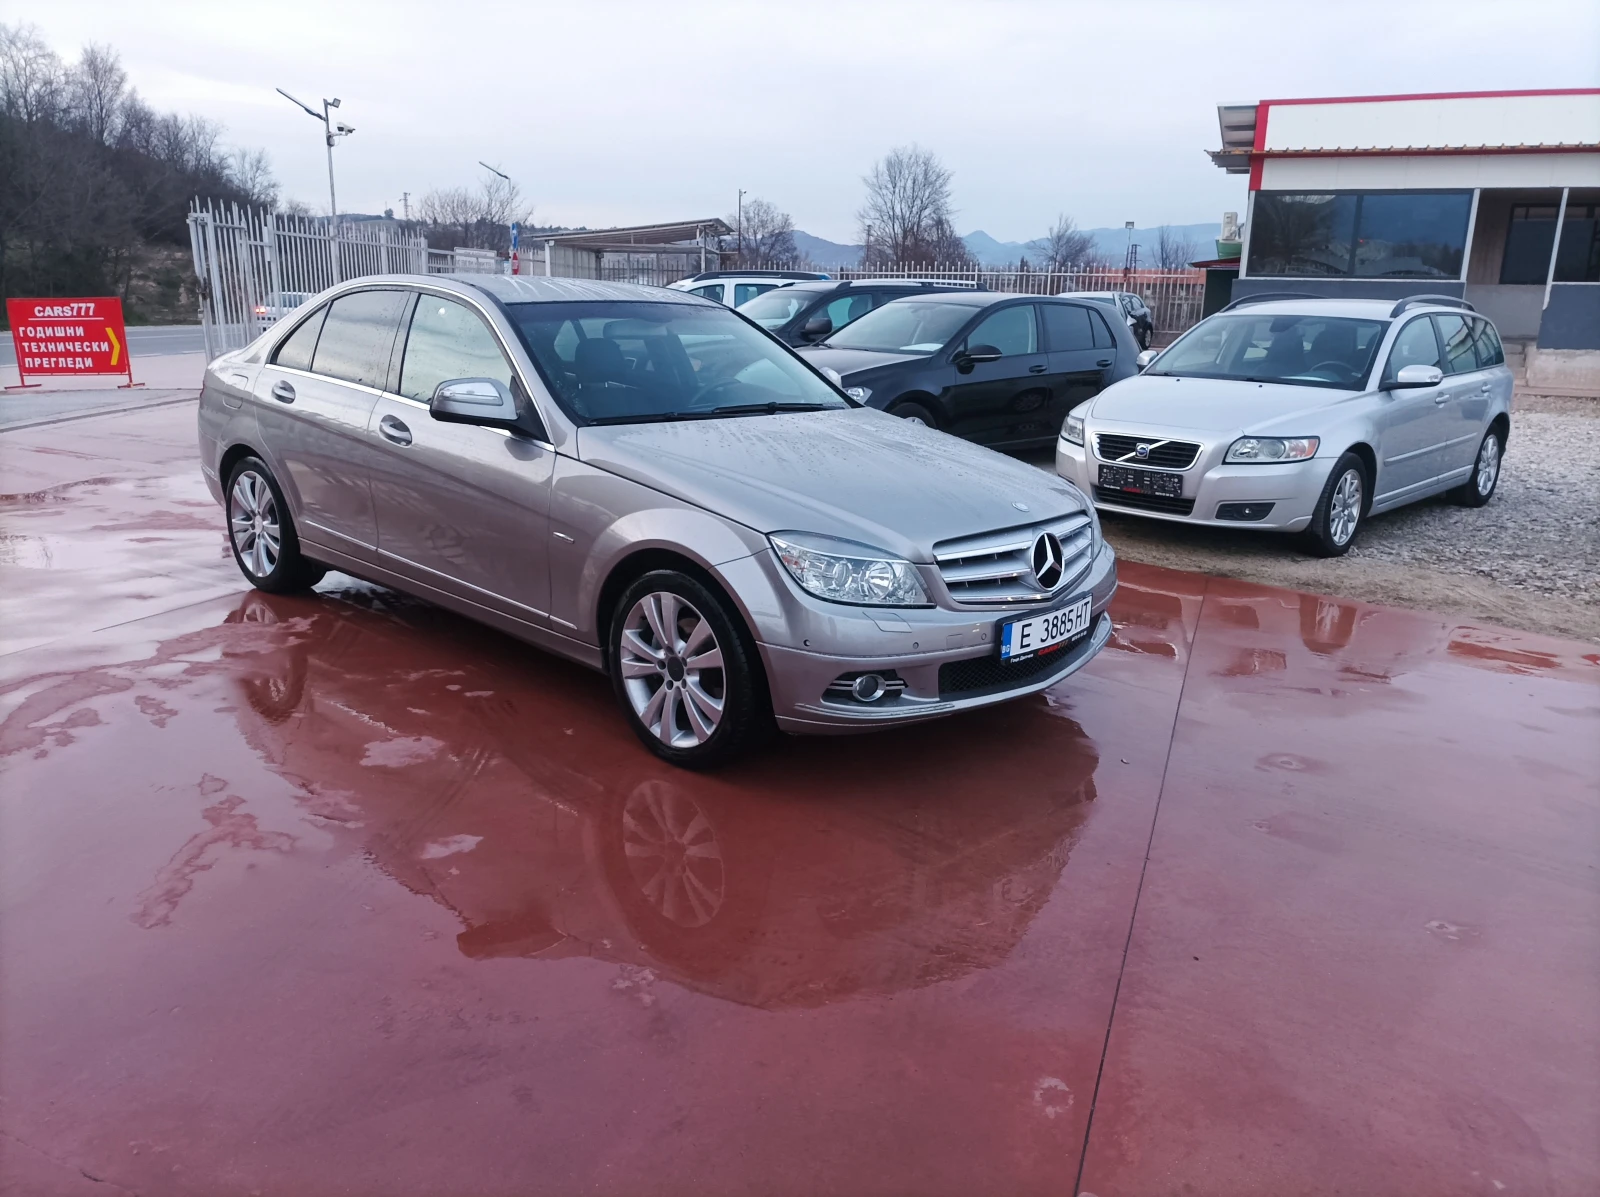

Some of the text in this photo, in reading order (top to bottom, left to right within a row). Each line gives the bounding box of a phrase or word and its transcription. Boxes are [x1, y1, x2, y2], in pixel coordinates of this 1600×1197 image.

[34, 303, 95, 317] CARS777
[19, 326, 85, 339] ГОДИШНИ
[22, 341, 110, 353] ТЕХНИЧЕСКИ
[24, 357, 94, 369] ПРЕГЛЕДИ
[1020, 623, 1032, 649] E
[1002, 645, 1011, 653] BG
